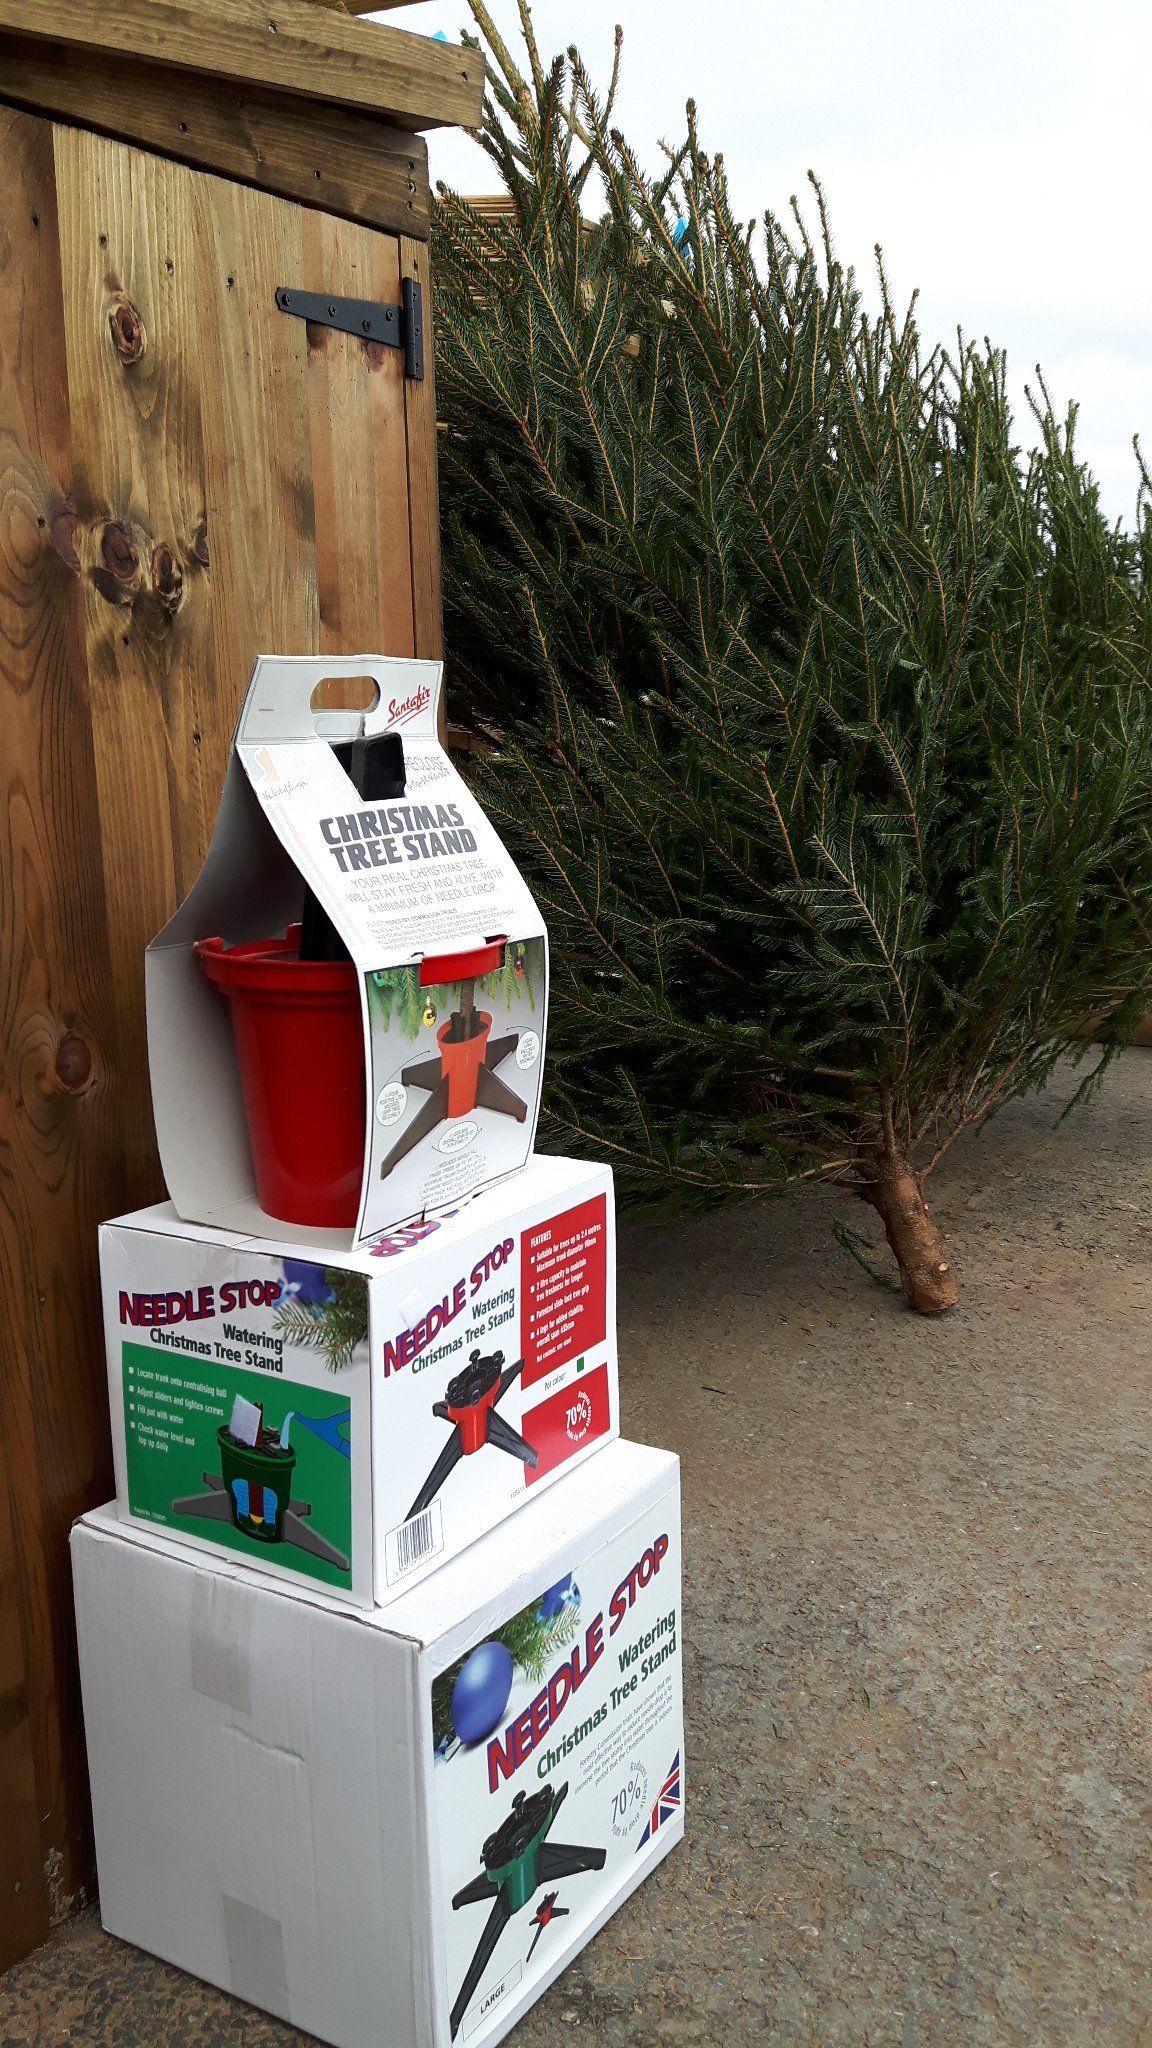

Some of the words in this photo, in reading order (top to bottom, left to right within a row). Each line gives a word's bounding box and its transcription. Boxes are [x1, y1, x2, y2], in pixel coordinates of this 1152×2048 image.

[387, 685, 431, 724] Santafir
[319, 803, 464, 845] CHRISTMAS
[329, 844, 402, 873] TREE
[402, 828, 478, 861] STAND
[345, 891, 371, 904] WILL
[371, 887, 399, 901] STAY
[398, 881, 433, 896] FRESH
[434, 876, 453, 889] AND
[481, 868, 504, 880] WITH
[351, 876, 381, 889] YOUR
[382, 873, 410, 885] REAL
[410, 862, 463, 879] CHRISTMAS
[465, 858, 487, 871] TREE
[368, 904, 376, 914] A
[376, 897, 422, 912] MINIMUM
[420, 894, 434, 906] OF
[435, 887, 473, 902] NEEDLE
[118, 1285, 216, 1327] NEEDLE
[219, 1279, 282, 1313] STOP
[383, 1277, 466, 1379] NEEDLE
[470, 1237, 515, 1297] STOP
[471, 1287, 515, 1320] Watering
[149, 1328, 212, 1357] Christmas
[213, 1341, 242, 1363] Tree
[245, 1350, 283, 1373] Stand
[222, 1323, 283, 1357] Watering
[411, 1334, 463, 1374] Christmas
[465, 1320, 486, 1344] Tree
[488, 1304, 515, 1333] Stand
[137, 1367, 154, 1380] Locate
[155, 1372, 169, 1383] trunk
[183, 1380, 215, 1397] centralising
[215, 1387, 227, 1398] ball
[137, 1386, 154, 1398] Adjust
[154, 1391, 173, 1403] sliders
[173, 1396, 184, 1406] and
[184, 1398, 204, 1411] tighten
[204, 1404, 224, 1416] screws
[137, 1404, 146, 1414] Fill
[146, 1409, 156, 1417] pot
[156, 1410, 168, 1420] with
[168, 1414, 184, 1424] water
[565, 1399, 587, 1429] 70%
[137, 1422, 154, 1435] Check
[154, 1428, 170, 1439] water
[170, 1432, 184, 1443] level
[184, 1437, 195, 1446] and
[138, 1435, 147, 1446] top
[147, 1439, 155, 1449] up
[155, 1441, 168, 1453] daily
[618, 1609, 676, 1674] Watering
[486, 1611, 605, 1795] NEEDLE
[608, 1533, 669, 1637] STOP
[536, 1702, 608, 1779] Christmas
[609, 1673, 638, 1710] Tree
[640, 1632, 677, 1683] Stand
[580, 1746, 597, 1768] Forestry
[597, 1723, 622, 1751] Commission
[622, 1712, 633, 1727] trials
[633, 1703, 643, 1716] have
[643, 1690, 656, 1705] shown
[656, 1680, 665, 1692] that
[582, 1761, 594, 1776] most
[594, 1744, 613, 1765] effective
[612, 1735, 622, 1749] way
[622, 1729, 627, 1738] to
[627, 1716, 641, 1733] reduce
[641, 1702, 655, 1719] needle
[654, 1692, 664, 1707] drop
[668, 1684, 672, 1692] to
[611, 1772, 641, 1824] 70%
[479, 1982, 506, 2015] LARGE
